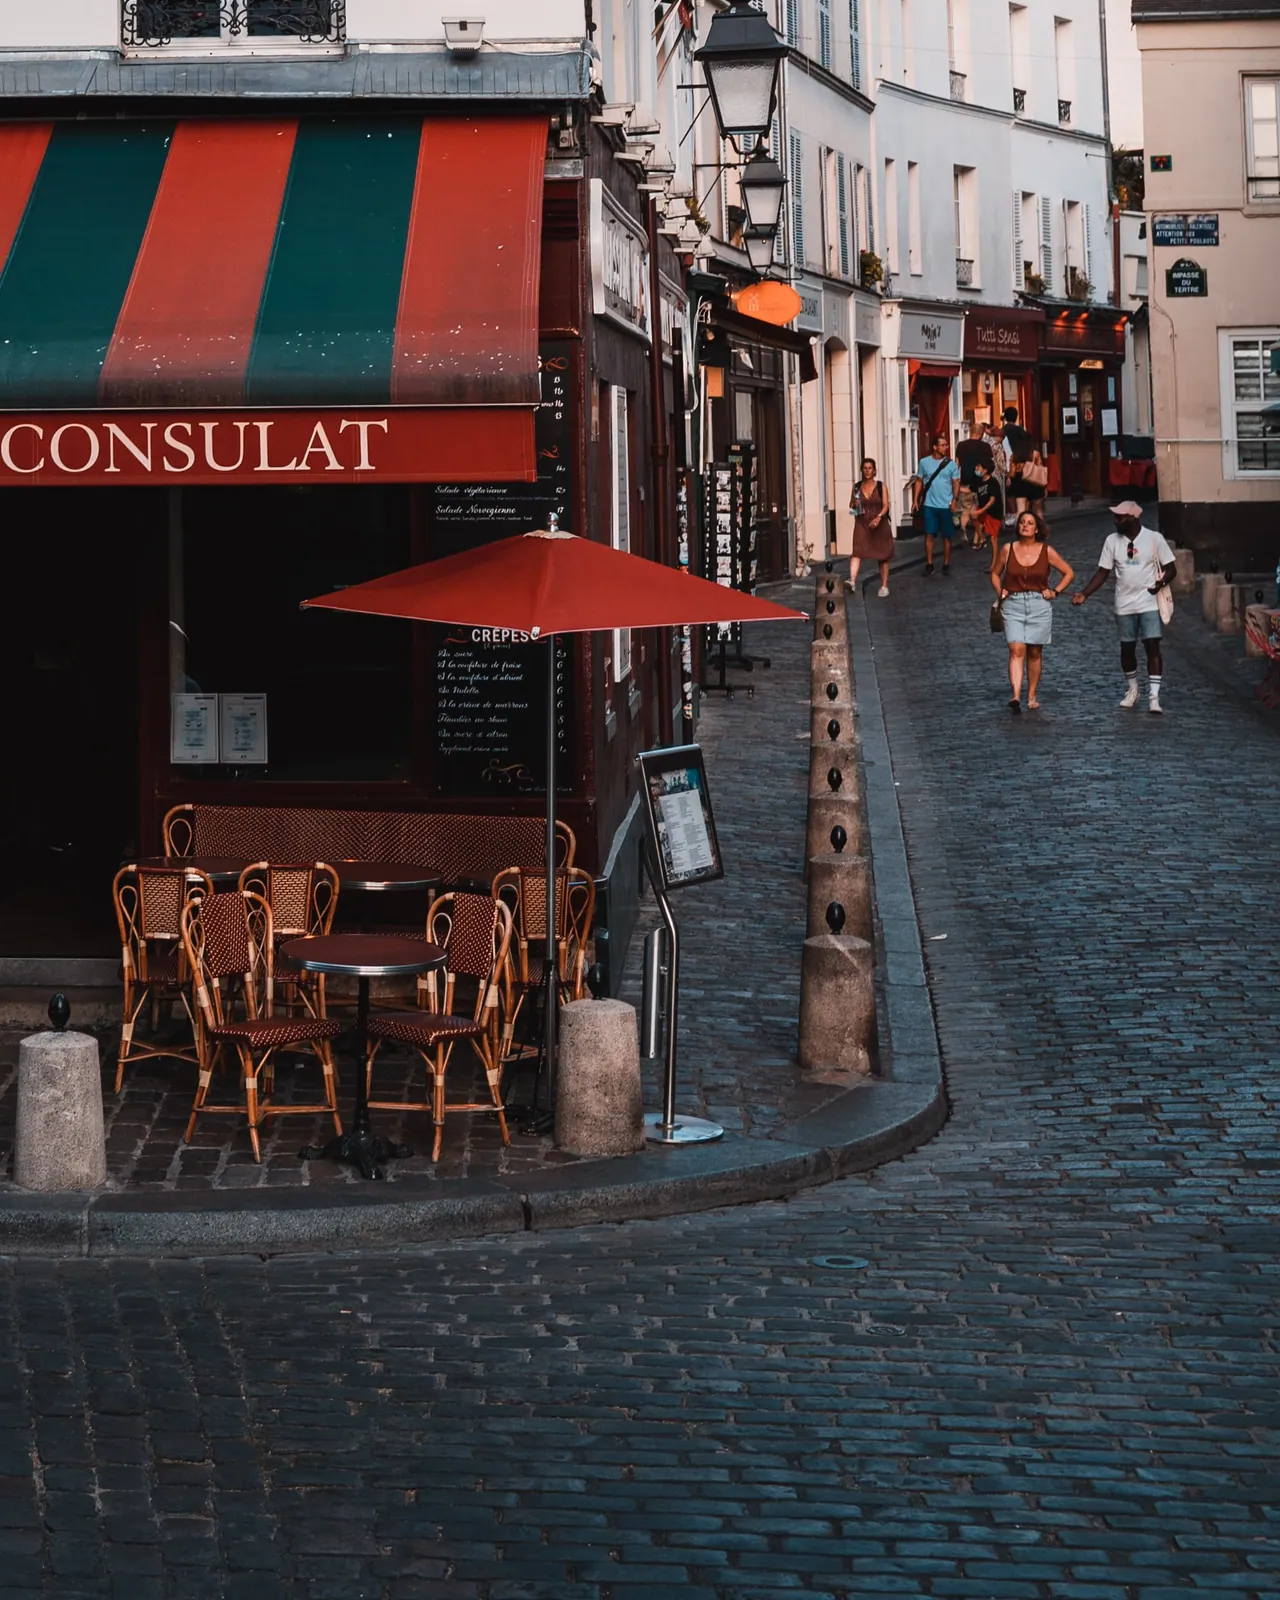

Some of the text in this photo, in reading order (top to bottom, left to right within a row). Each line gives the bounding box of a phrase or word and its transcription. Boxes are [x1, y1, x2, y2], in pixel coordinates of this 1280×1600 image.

[1170, 237, 1188, 245] PETITS
[1172, 271, 1200, 279] IMPASSE
[1174, 286, 1200, 294] TERTRE
[976, 323, 1021, 345] Tutti Sensi
[0, 418, 389, 474] CONSULAT
[434, 485, 460, 494] Salade
[435, 504, 463, 515] Salade
[490, 660, 500, 669] de
[501, 661, 522, 673] fraise
[451, 685, 480, 695] Nutella
[482, 700, 492, 708] de
[486, 729, 508, 738] citron
